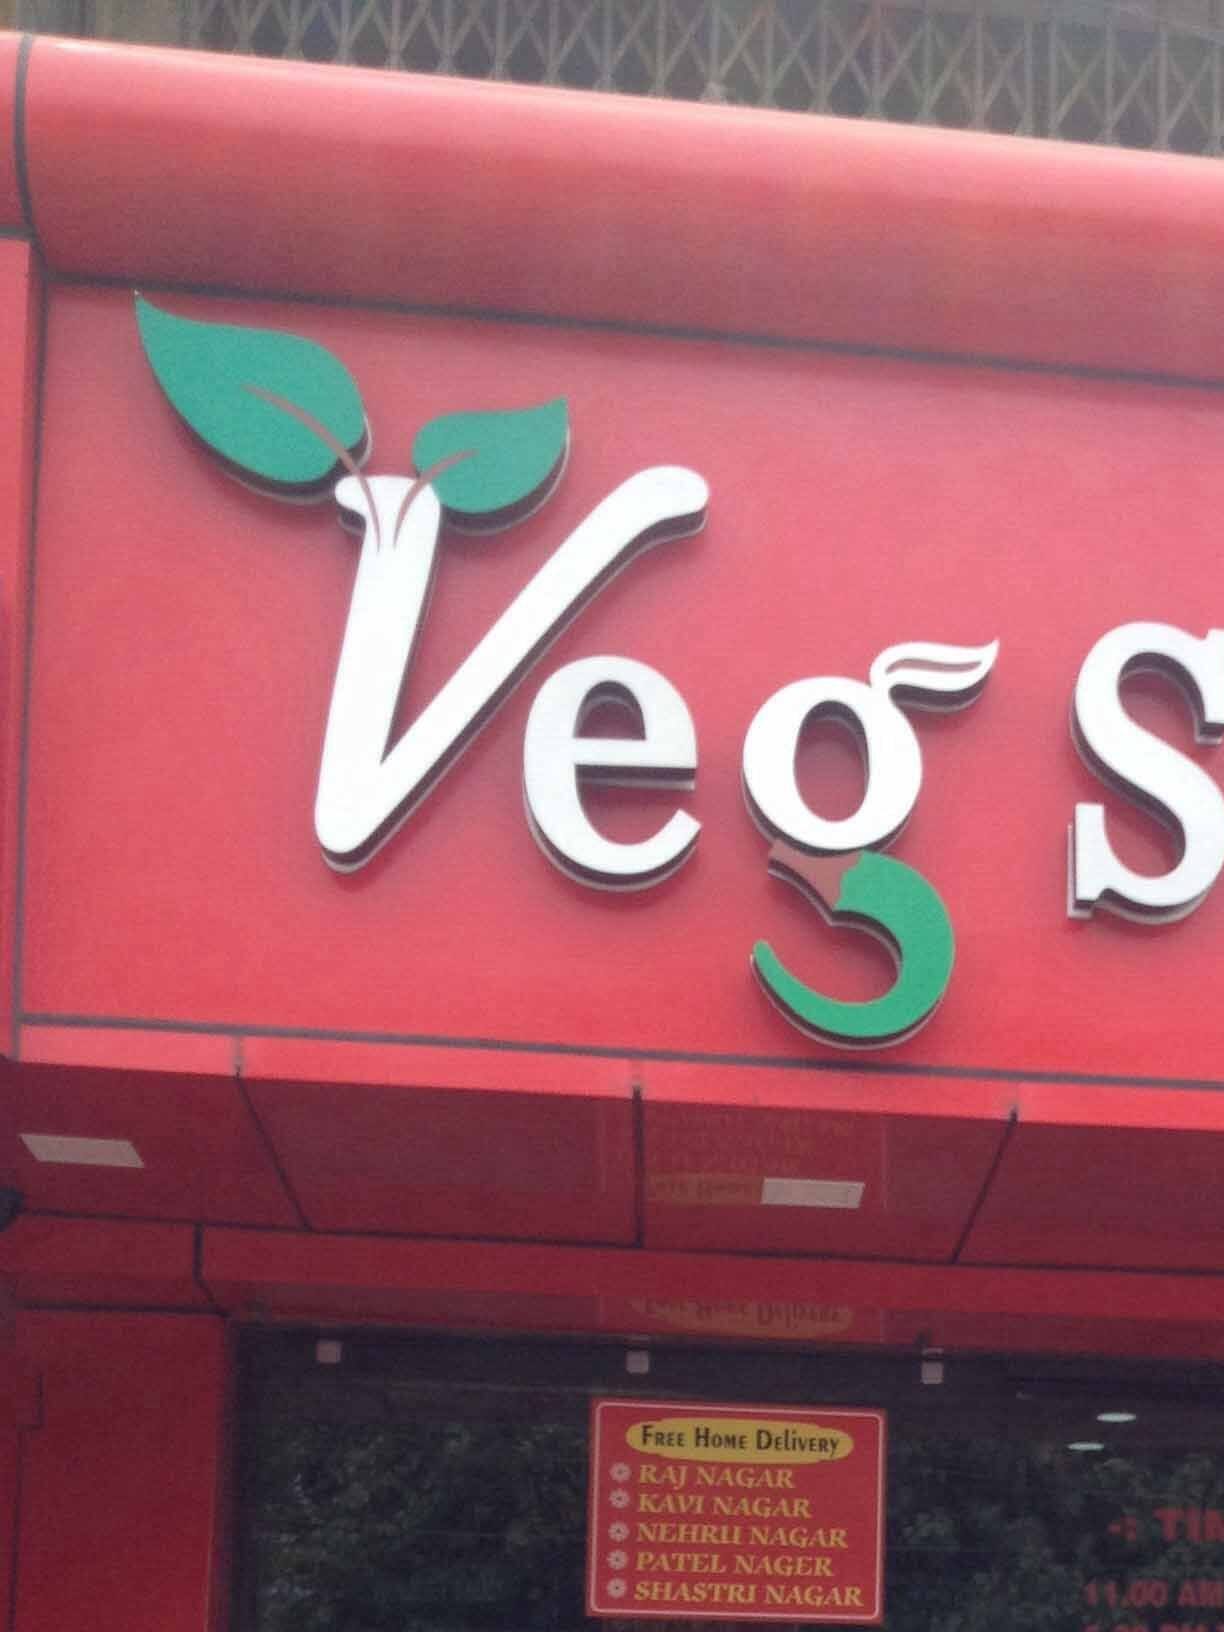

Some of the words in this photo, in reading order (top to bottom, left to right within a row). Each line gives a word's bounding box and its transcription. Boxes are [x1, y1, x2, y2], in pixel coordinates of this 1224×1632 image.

[313, 464, 998, 1046] Veg
[638, 1463, 688, 1491] RAJ
[695, 1465, 795, 1489] NAGAR
[636, 1492, 704, 1515] KAVI
[711, 1495, 812, 1519] NAGAR
[635, 1522, 741, 1545] NEHRU
[748, 1526, 848, 1549] NAGAR
[634, 1551, 727, 1574] PATEL
[733, 1553, 834, 1577] NAGER
[633, 1580, 756, 1603] SHASTRI
[764, 1584, 864, 1607] NAGAR
[1083, 1580, 1169, 1609] 11.00
[1178, 1580, 1224, 1608] AM
